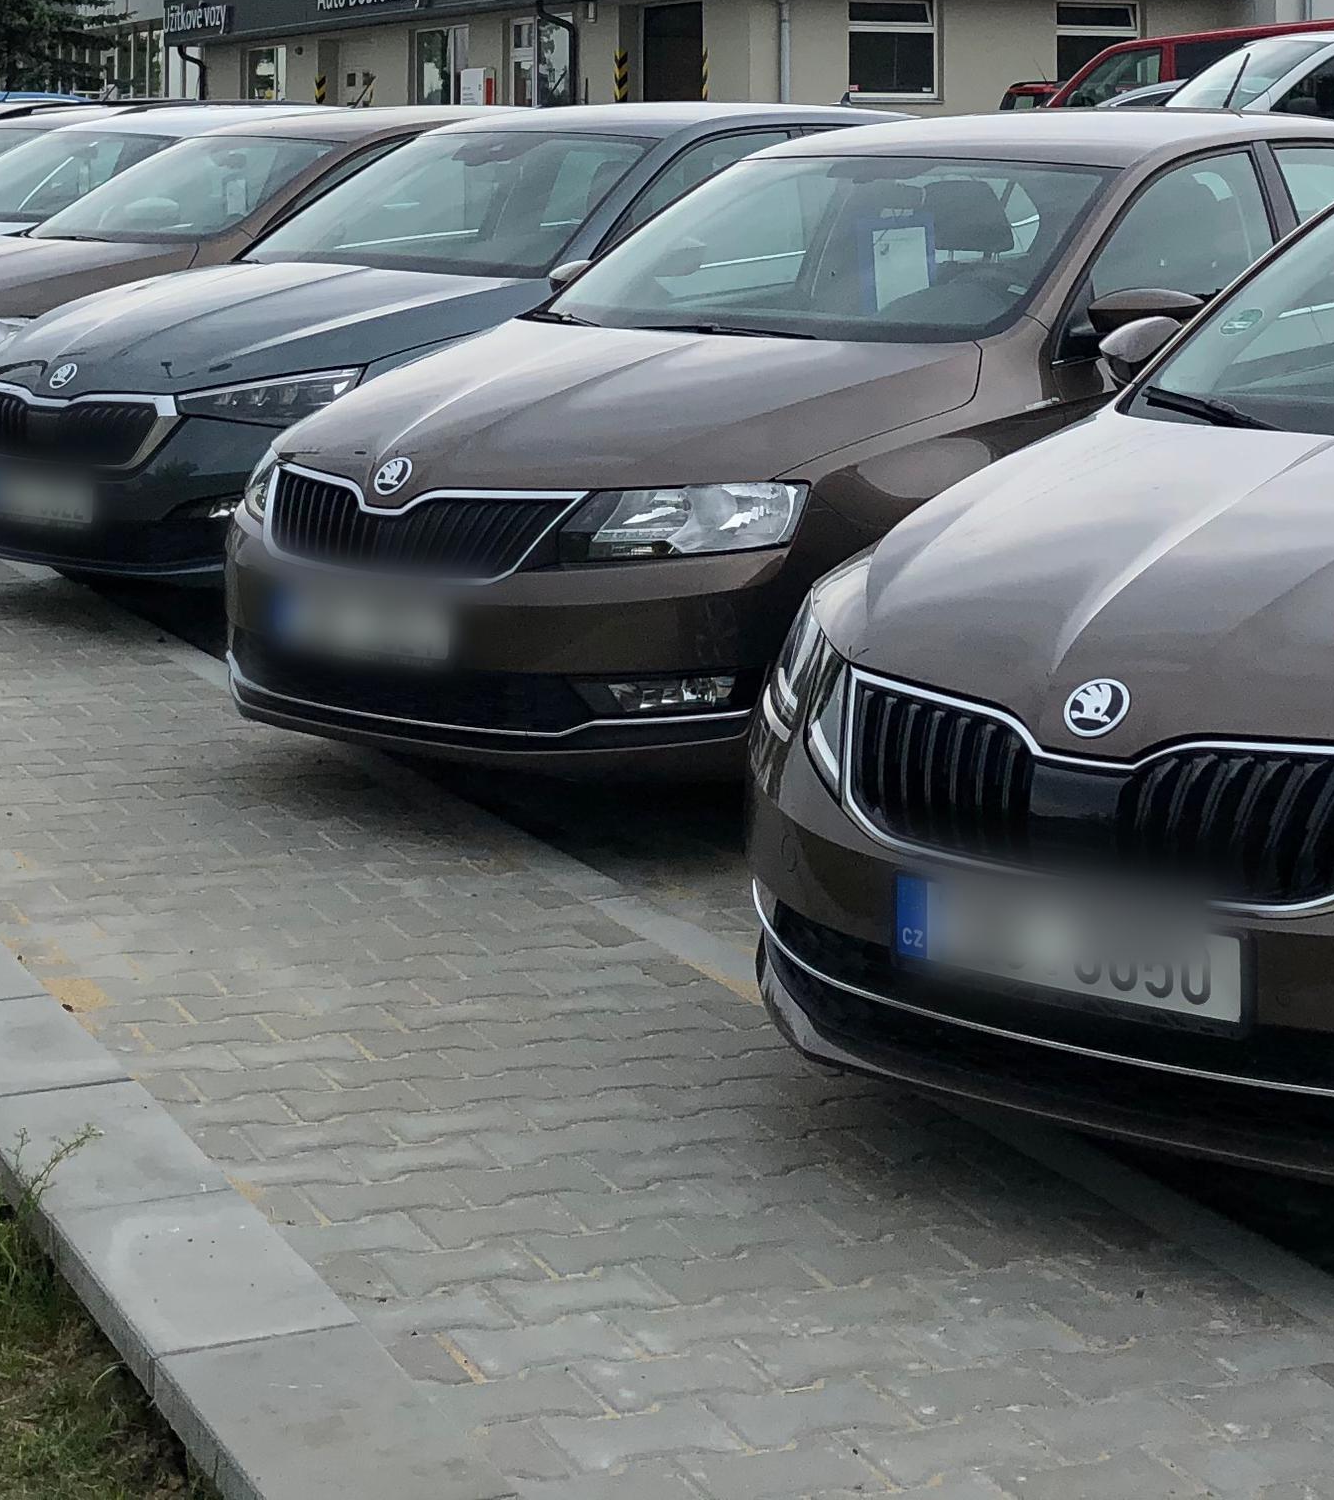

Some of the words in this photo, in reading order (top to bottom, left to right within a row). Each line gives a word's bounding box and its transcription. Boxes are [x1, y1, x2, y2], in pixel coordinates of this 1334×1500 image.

[163, 0, 203, 34] Užitkové
[204, 4, 227, 35] vozy
[902, 927, 924, 948] CZ
